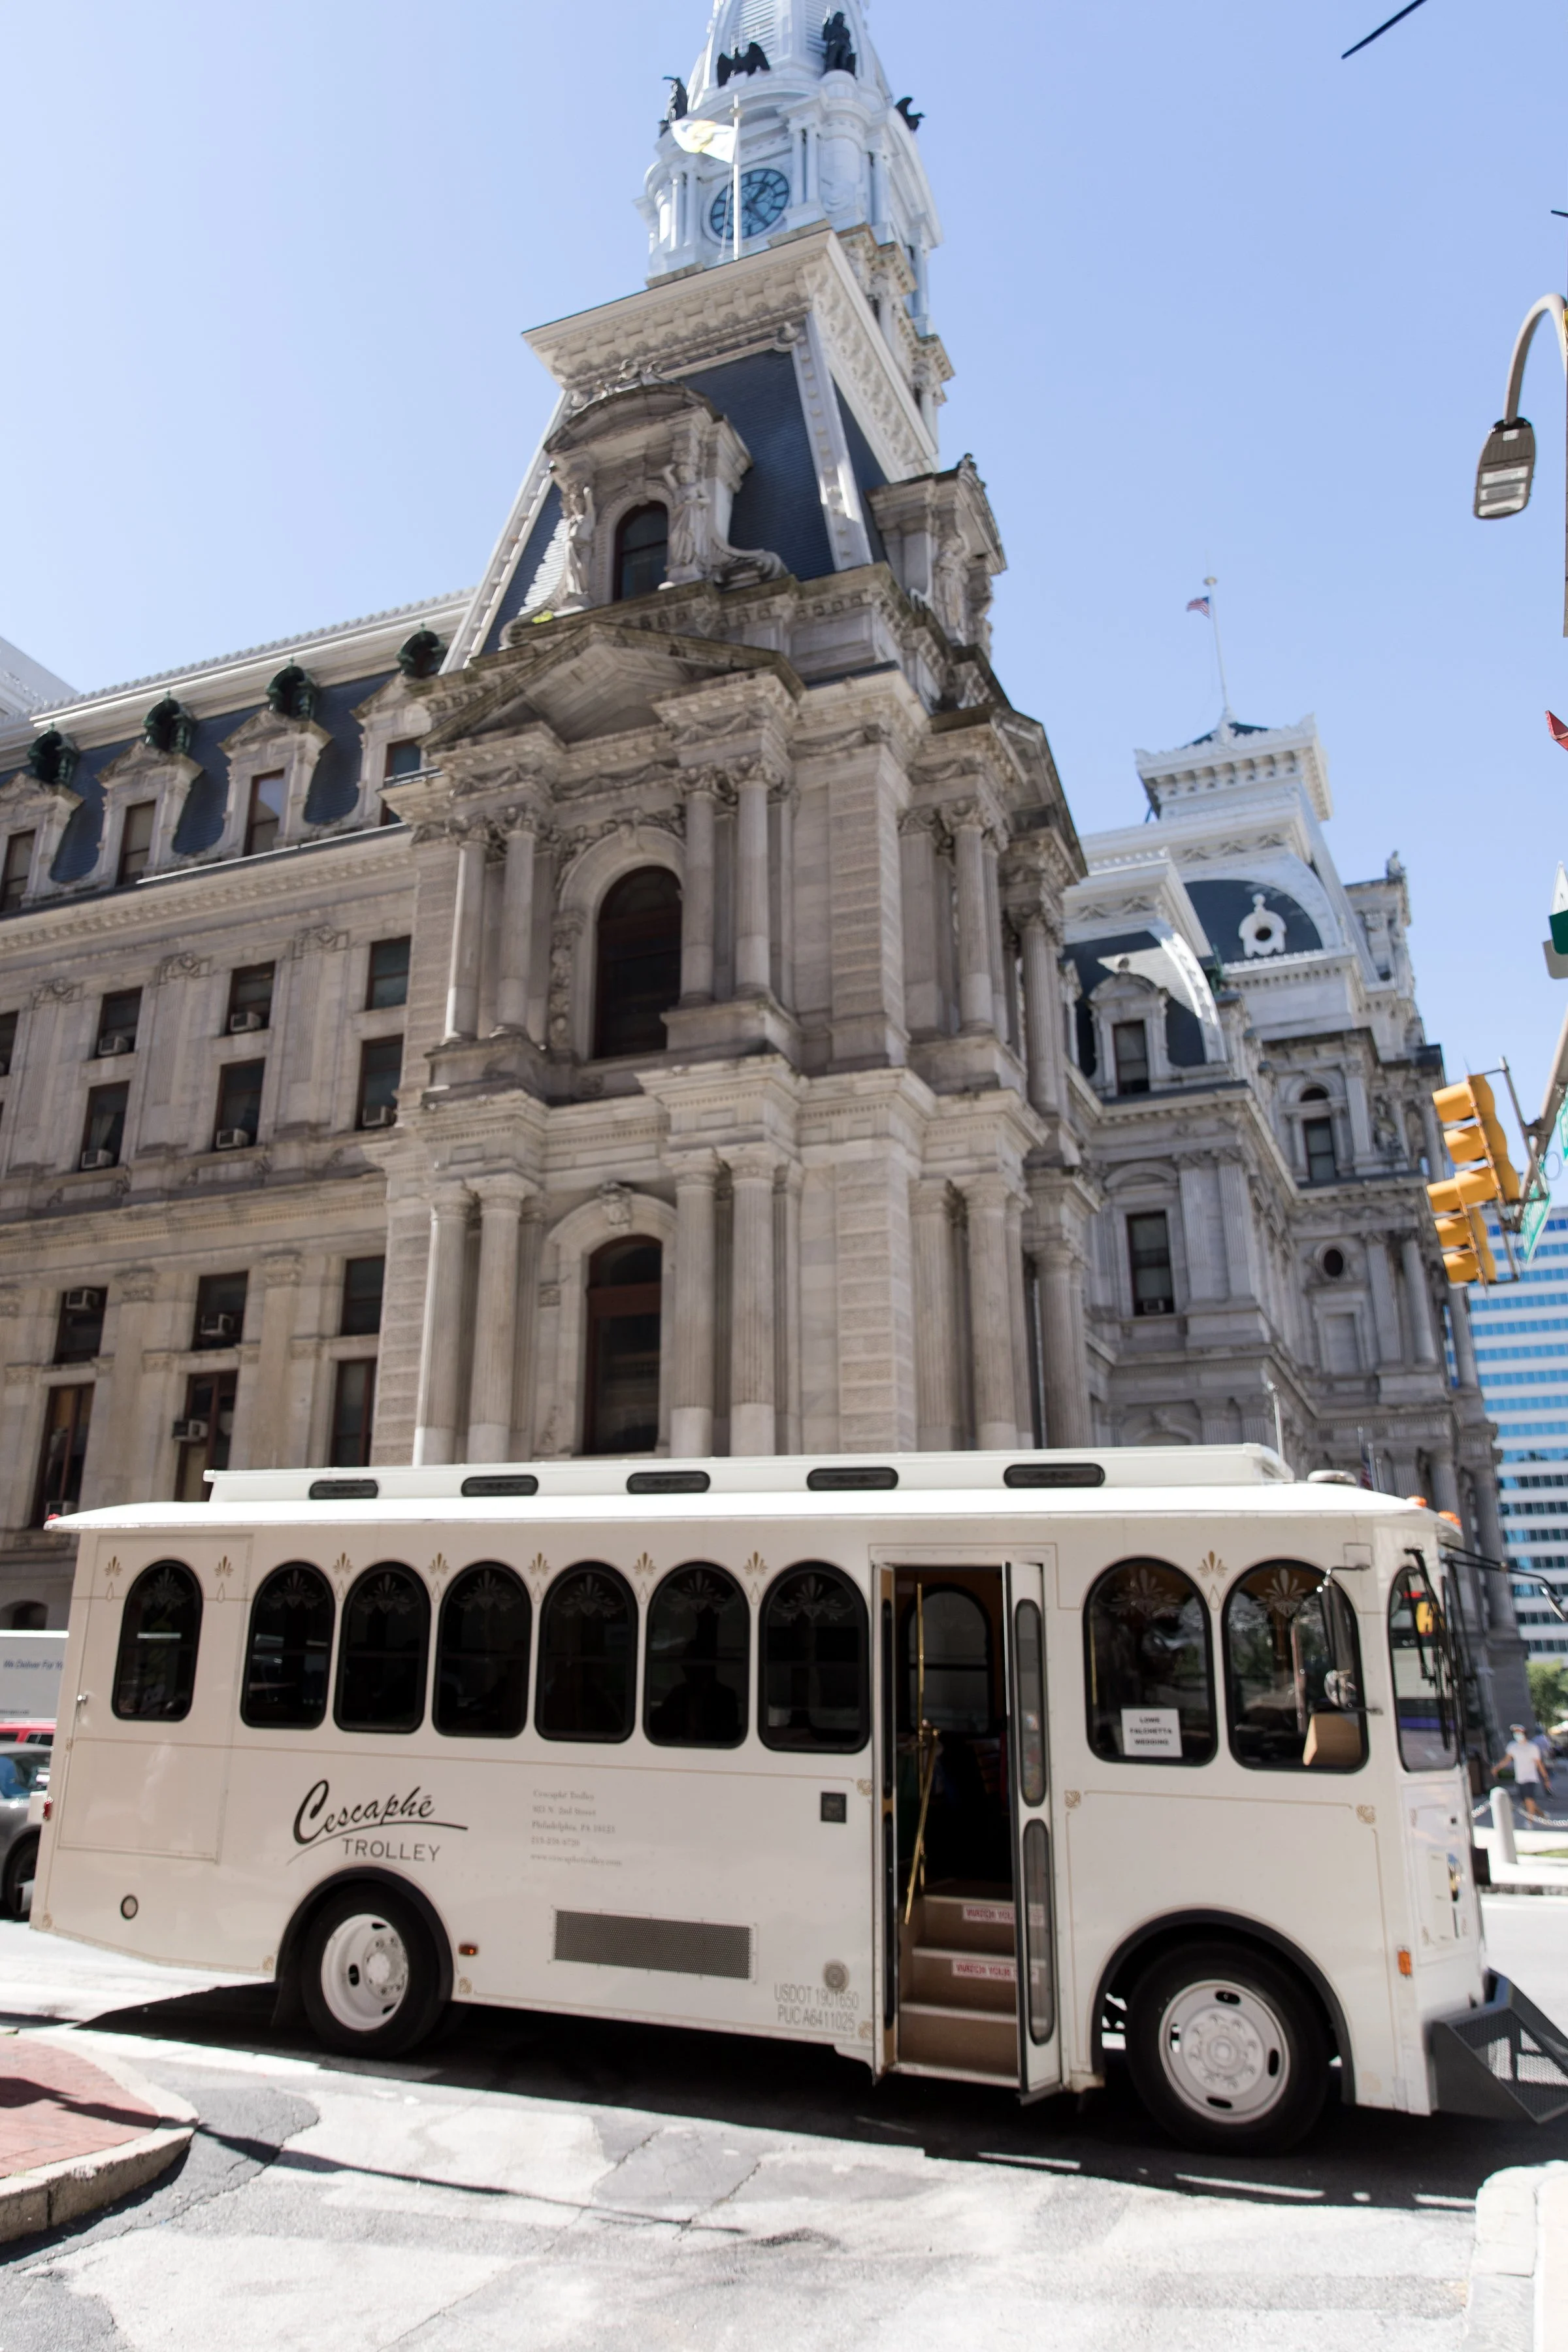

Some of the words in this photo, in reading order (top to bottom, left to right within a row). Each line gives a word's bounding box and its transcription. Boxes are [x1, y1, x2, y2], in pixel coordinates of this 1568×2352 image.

[342, 1838, 440, 1862] TROLLEY
[774, 1982, 812, 2005] USDOT
[777, 2004, 801, 2026] PUC
